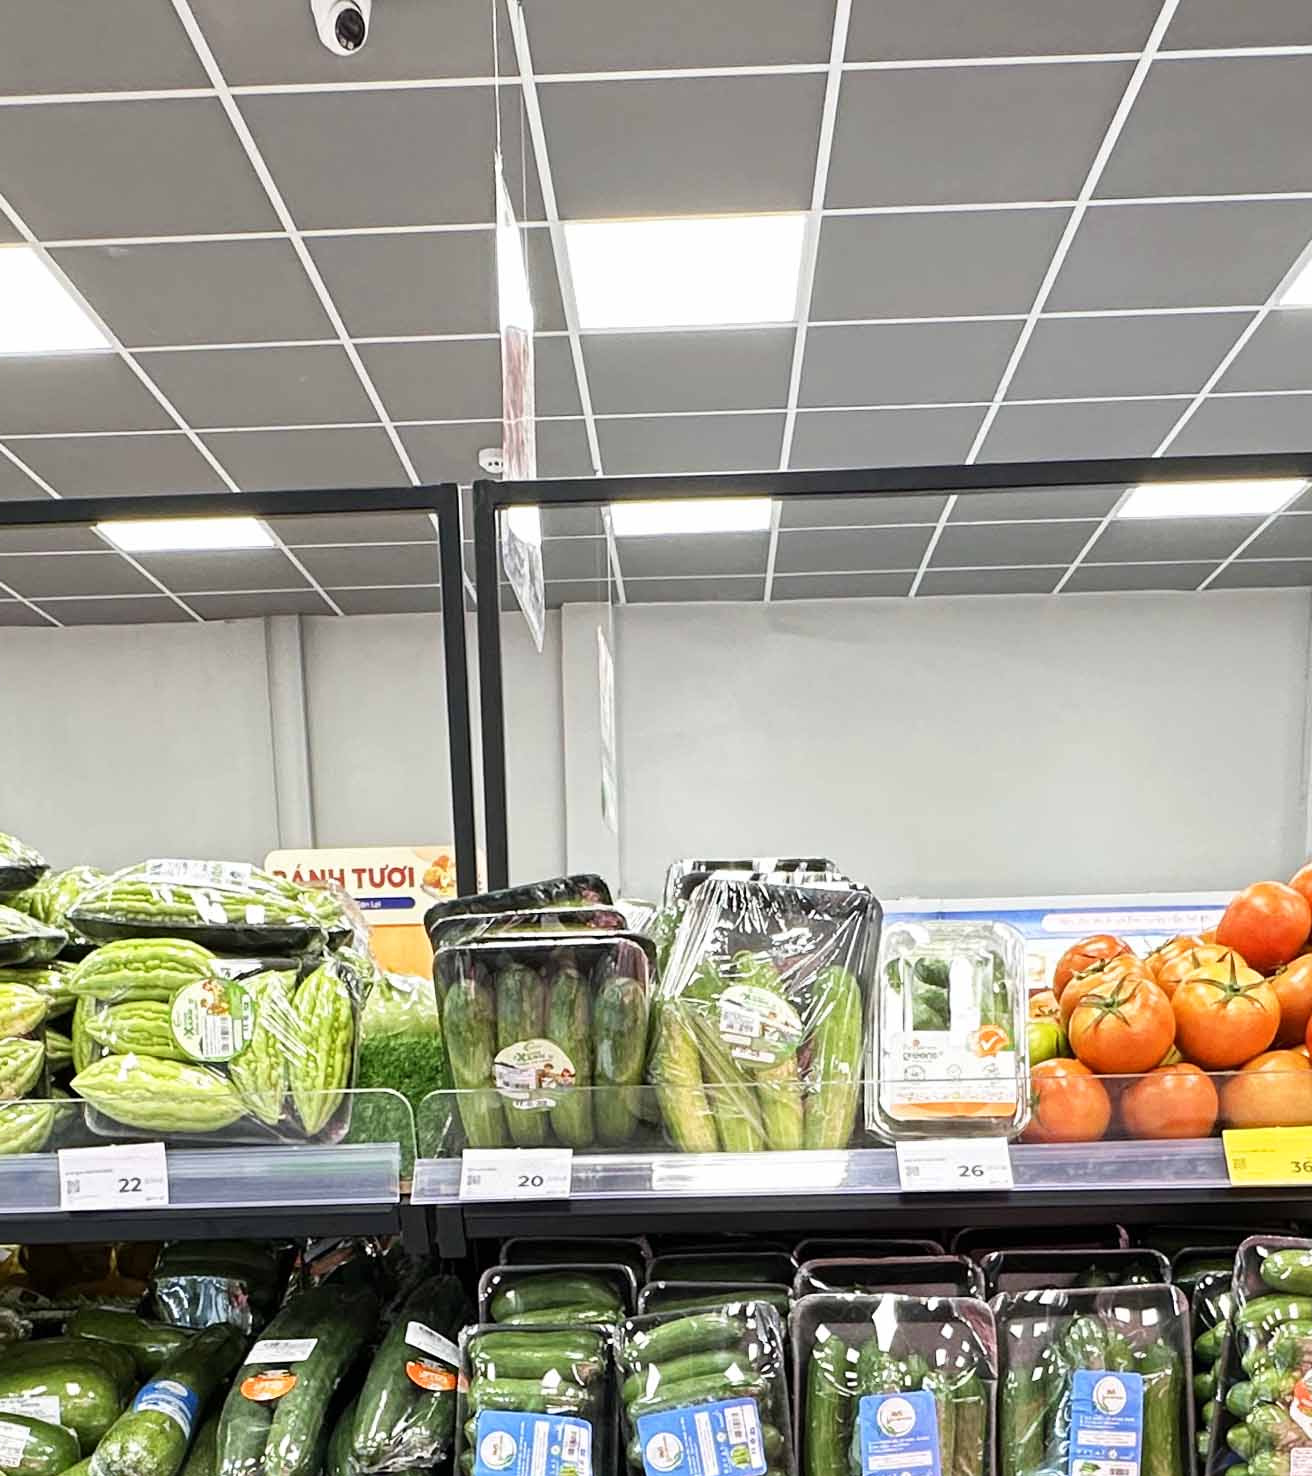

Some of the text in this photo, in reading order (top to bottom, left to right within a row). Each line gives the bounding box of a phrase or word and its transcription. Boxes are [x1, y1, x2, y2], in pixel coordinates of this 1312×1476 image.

[351, 864, 415, 889] TƯƠI
[957, 1164, 985, 1177] 26
[118, 1177, 143, 1194] 22
[518, 1175, 544, 1188] 20
